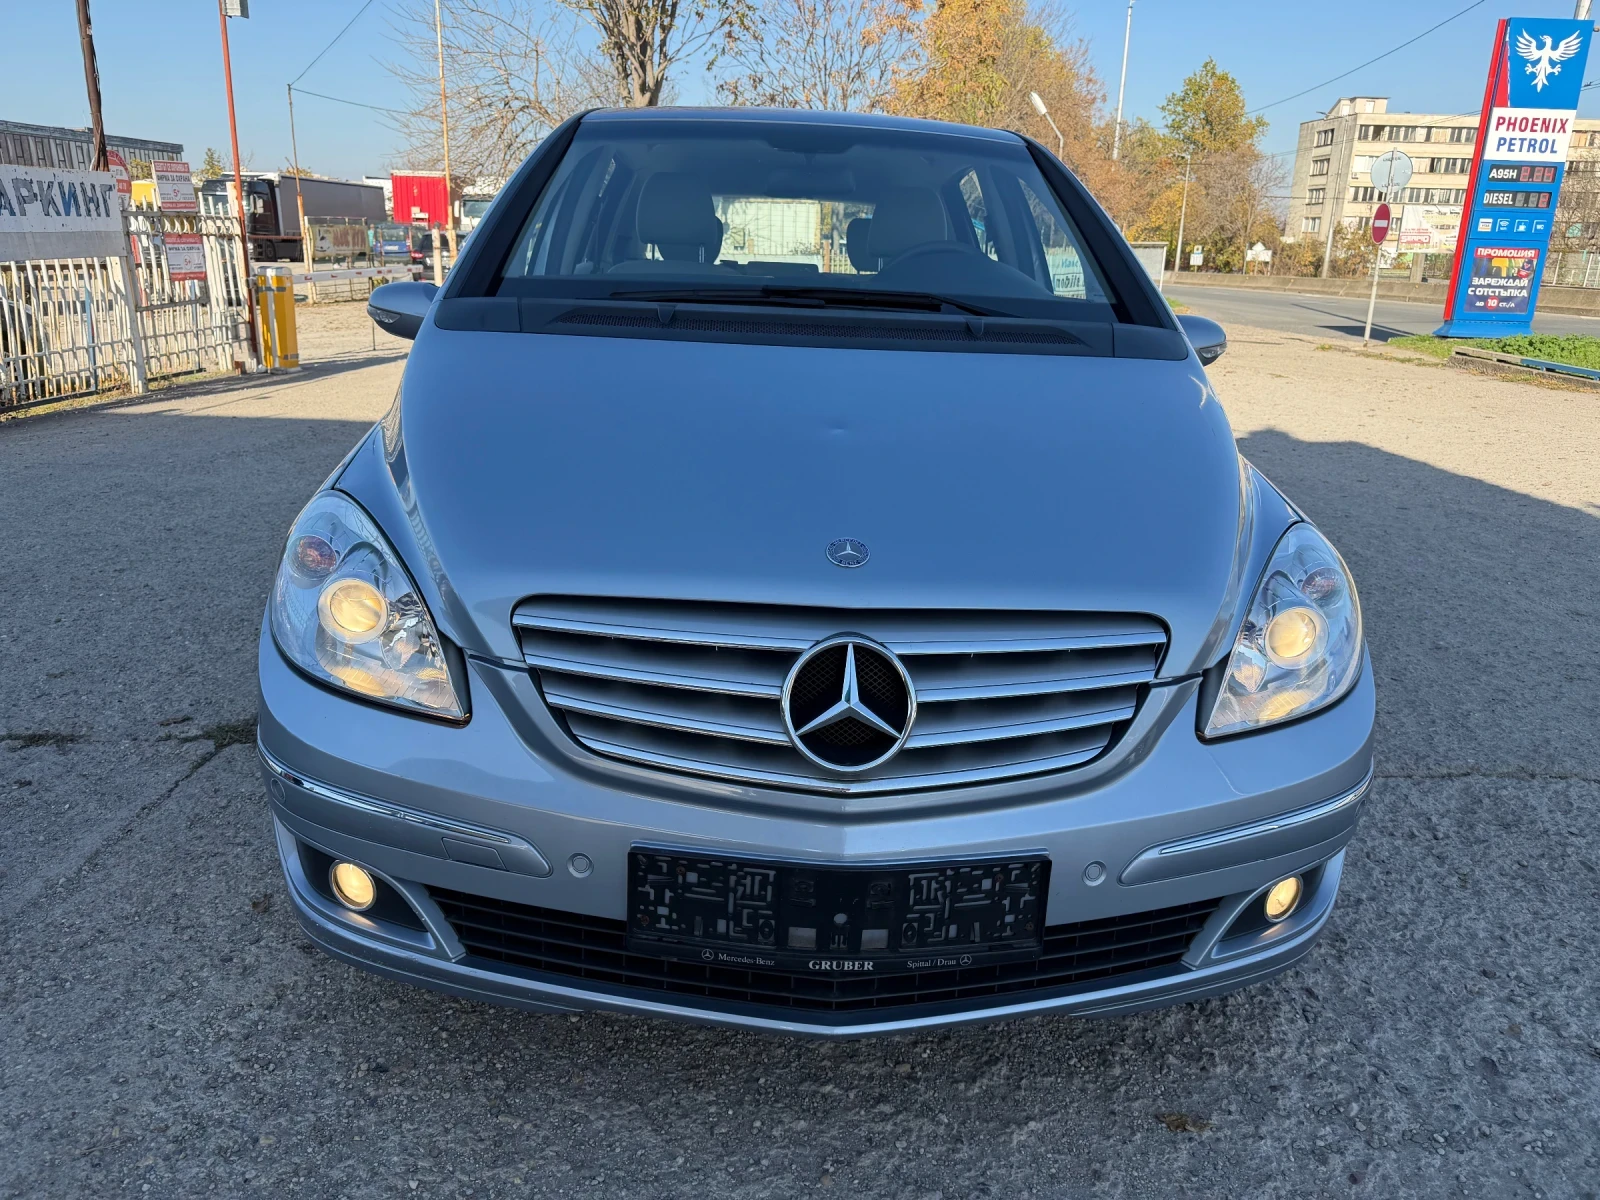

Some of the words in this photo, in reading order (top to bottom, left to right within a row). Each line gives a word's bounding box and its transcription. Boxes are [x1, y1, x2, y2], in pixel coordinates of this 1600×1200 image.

[1495, 116, 1569, 133] PHOENIX
[1496, 137, 1558, 154] PETROL
[1483, 193, 1513, 205] DIESEL
[1477, 248, 1535, 257] ПРОМОЦИЯ
[1471, 277, 1529, 287] ЗАРЕЖДАЙ
[1475, 288, 1528, 297] ОТСТЪПКА
[1487, 299, 1497, 307] 10
[718, 953, 775, 966] Mercedes-Benz
[808, 960, 874, 971] GRUBER
